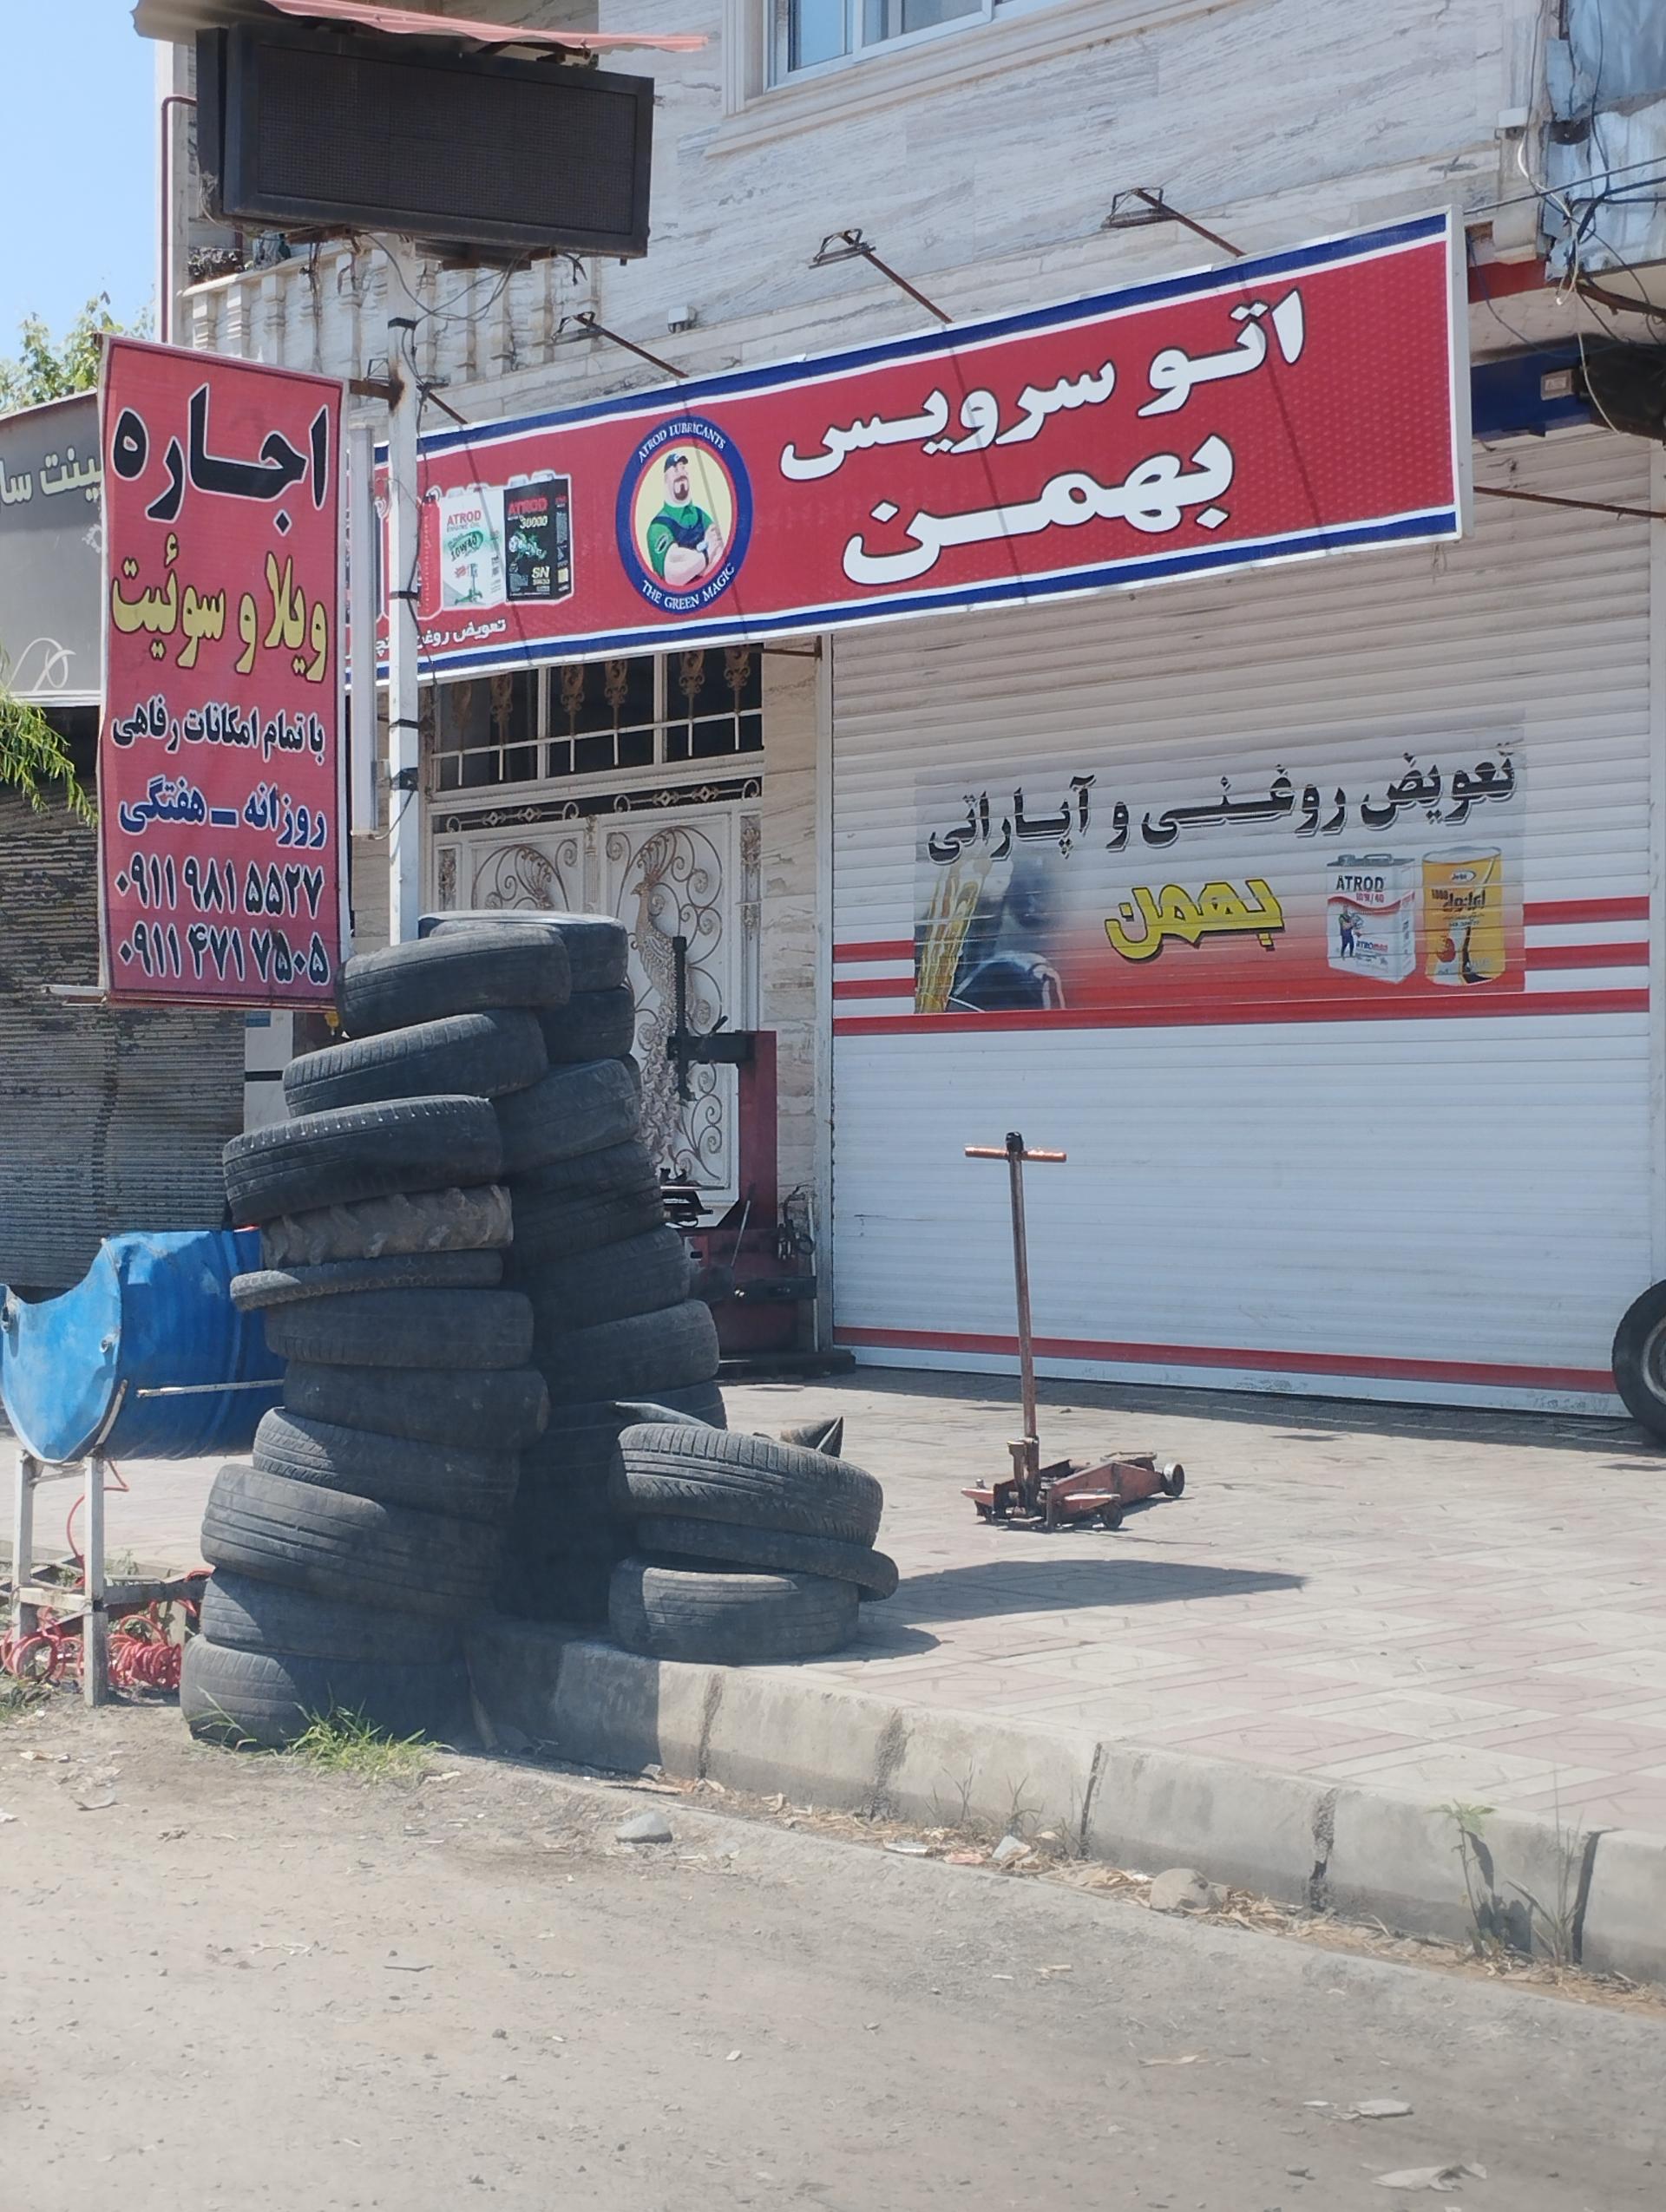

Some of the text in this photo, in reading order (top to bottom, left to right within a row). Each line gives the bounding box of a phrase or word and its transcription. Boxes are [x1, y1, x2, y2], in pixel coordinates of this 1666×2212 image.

[780, 288, 1304, 481] اتو سرویس
[111, 382, 330, 537] اجاره
[639, 422, 725, 463] ATROD LUBRICANTS
[447, 509, 482, 527] ATROD
[842, 434, 1234, 586] بهمن
[111, 533, 226, 670] سوئیت
[263, 552, 329, 683] ویلا
[642, 562, 735, 611] THE GREEN MAGIC
[235, 592, 258, 675] و
[452, 618, 507, 644] تعویض
[111, 693, 325, 766] با تمام امکانات رفاهی
[118, 773, 207, 837] هفتگی
[244, 782, 328, 849] روزانه
[928, 741, 1517, 866] تعویض روغنی و آپاراتی
[115, 852, 325, 920] ۰۹۱۱ ۹۸۱ ۵۵۲۷
[1335, 875, 1386, 893] ATROD
[118, 919, 331, 986] ۰۹۱۱ ۴۷۱ ۷۵۰۵
[1105, 879, 1285, 965] بهمن
